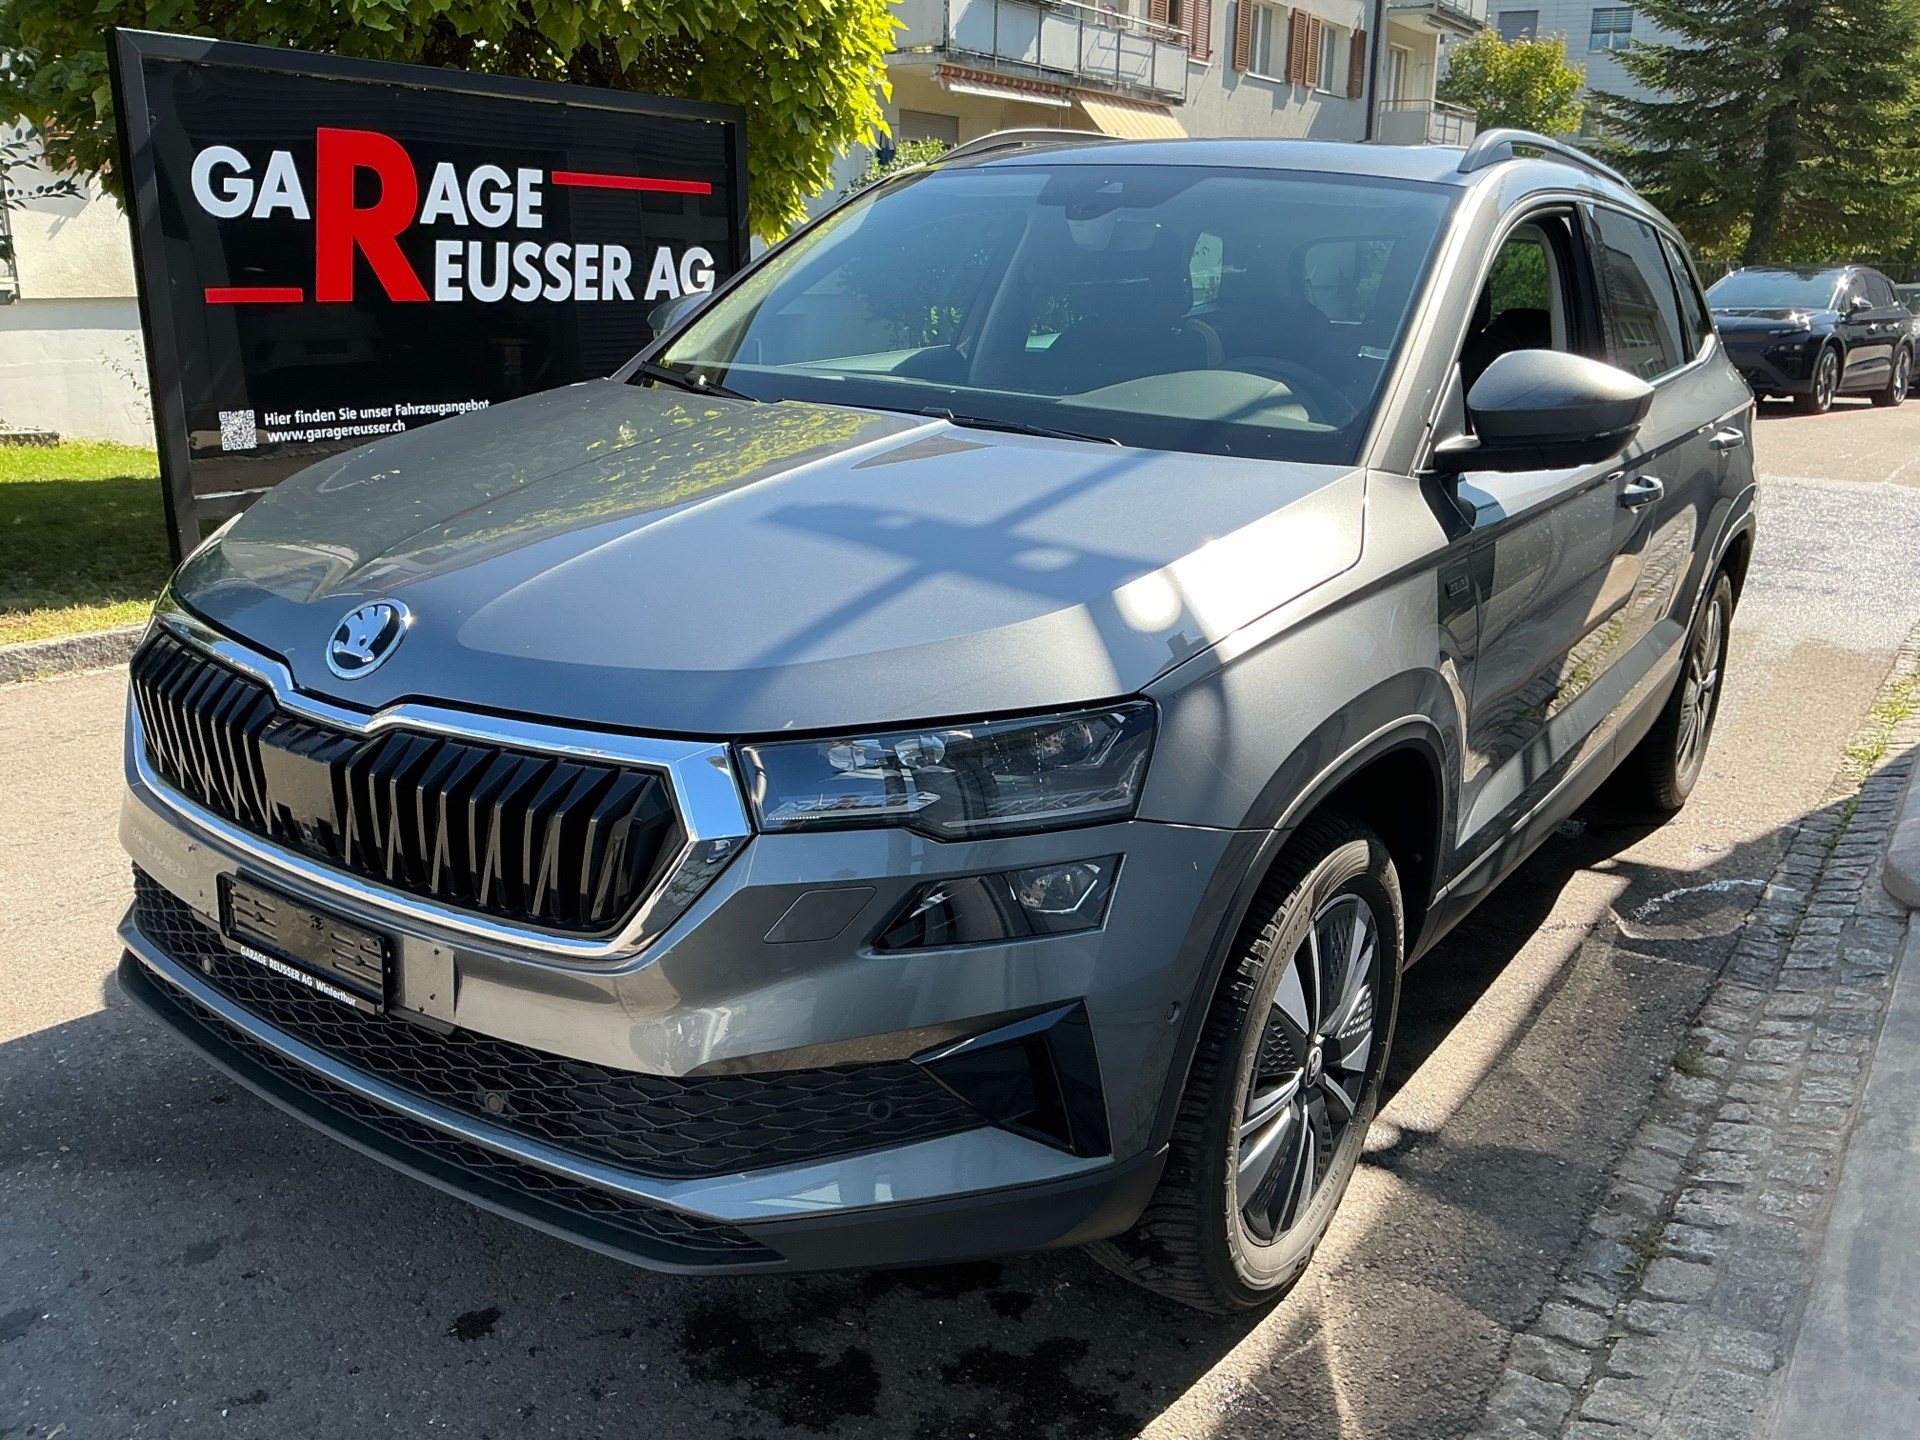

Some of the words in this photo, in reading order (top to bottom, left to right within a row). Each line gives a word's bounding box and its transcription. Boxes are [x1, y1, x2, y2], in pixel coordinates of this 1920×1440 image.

[191, 127, 543, 302] GARAGE
[644, 247, 715, 300] AG
[264, 412, 291, 426] Hier
[294, 404, 336, 423] finden
[339, 407, 357, 420] Sie
[360, 406, 393, 419] unser
[395, 399, 490, 416] Fahrzeugangebot
[267, 420, 406, 442] www.garagereusser.ch
[240, 945, 267, 966] GARAGE
[269, 958, 301, 982] REUSSER
[301, 973, 313, 987] AG
[315, 980, 357, 1006] Winterthur
